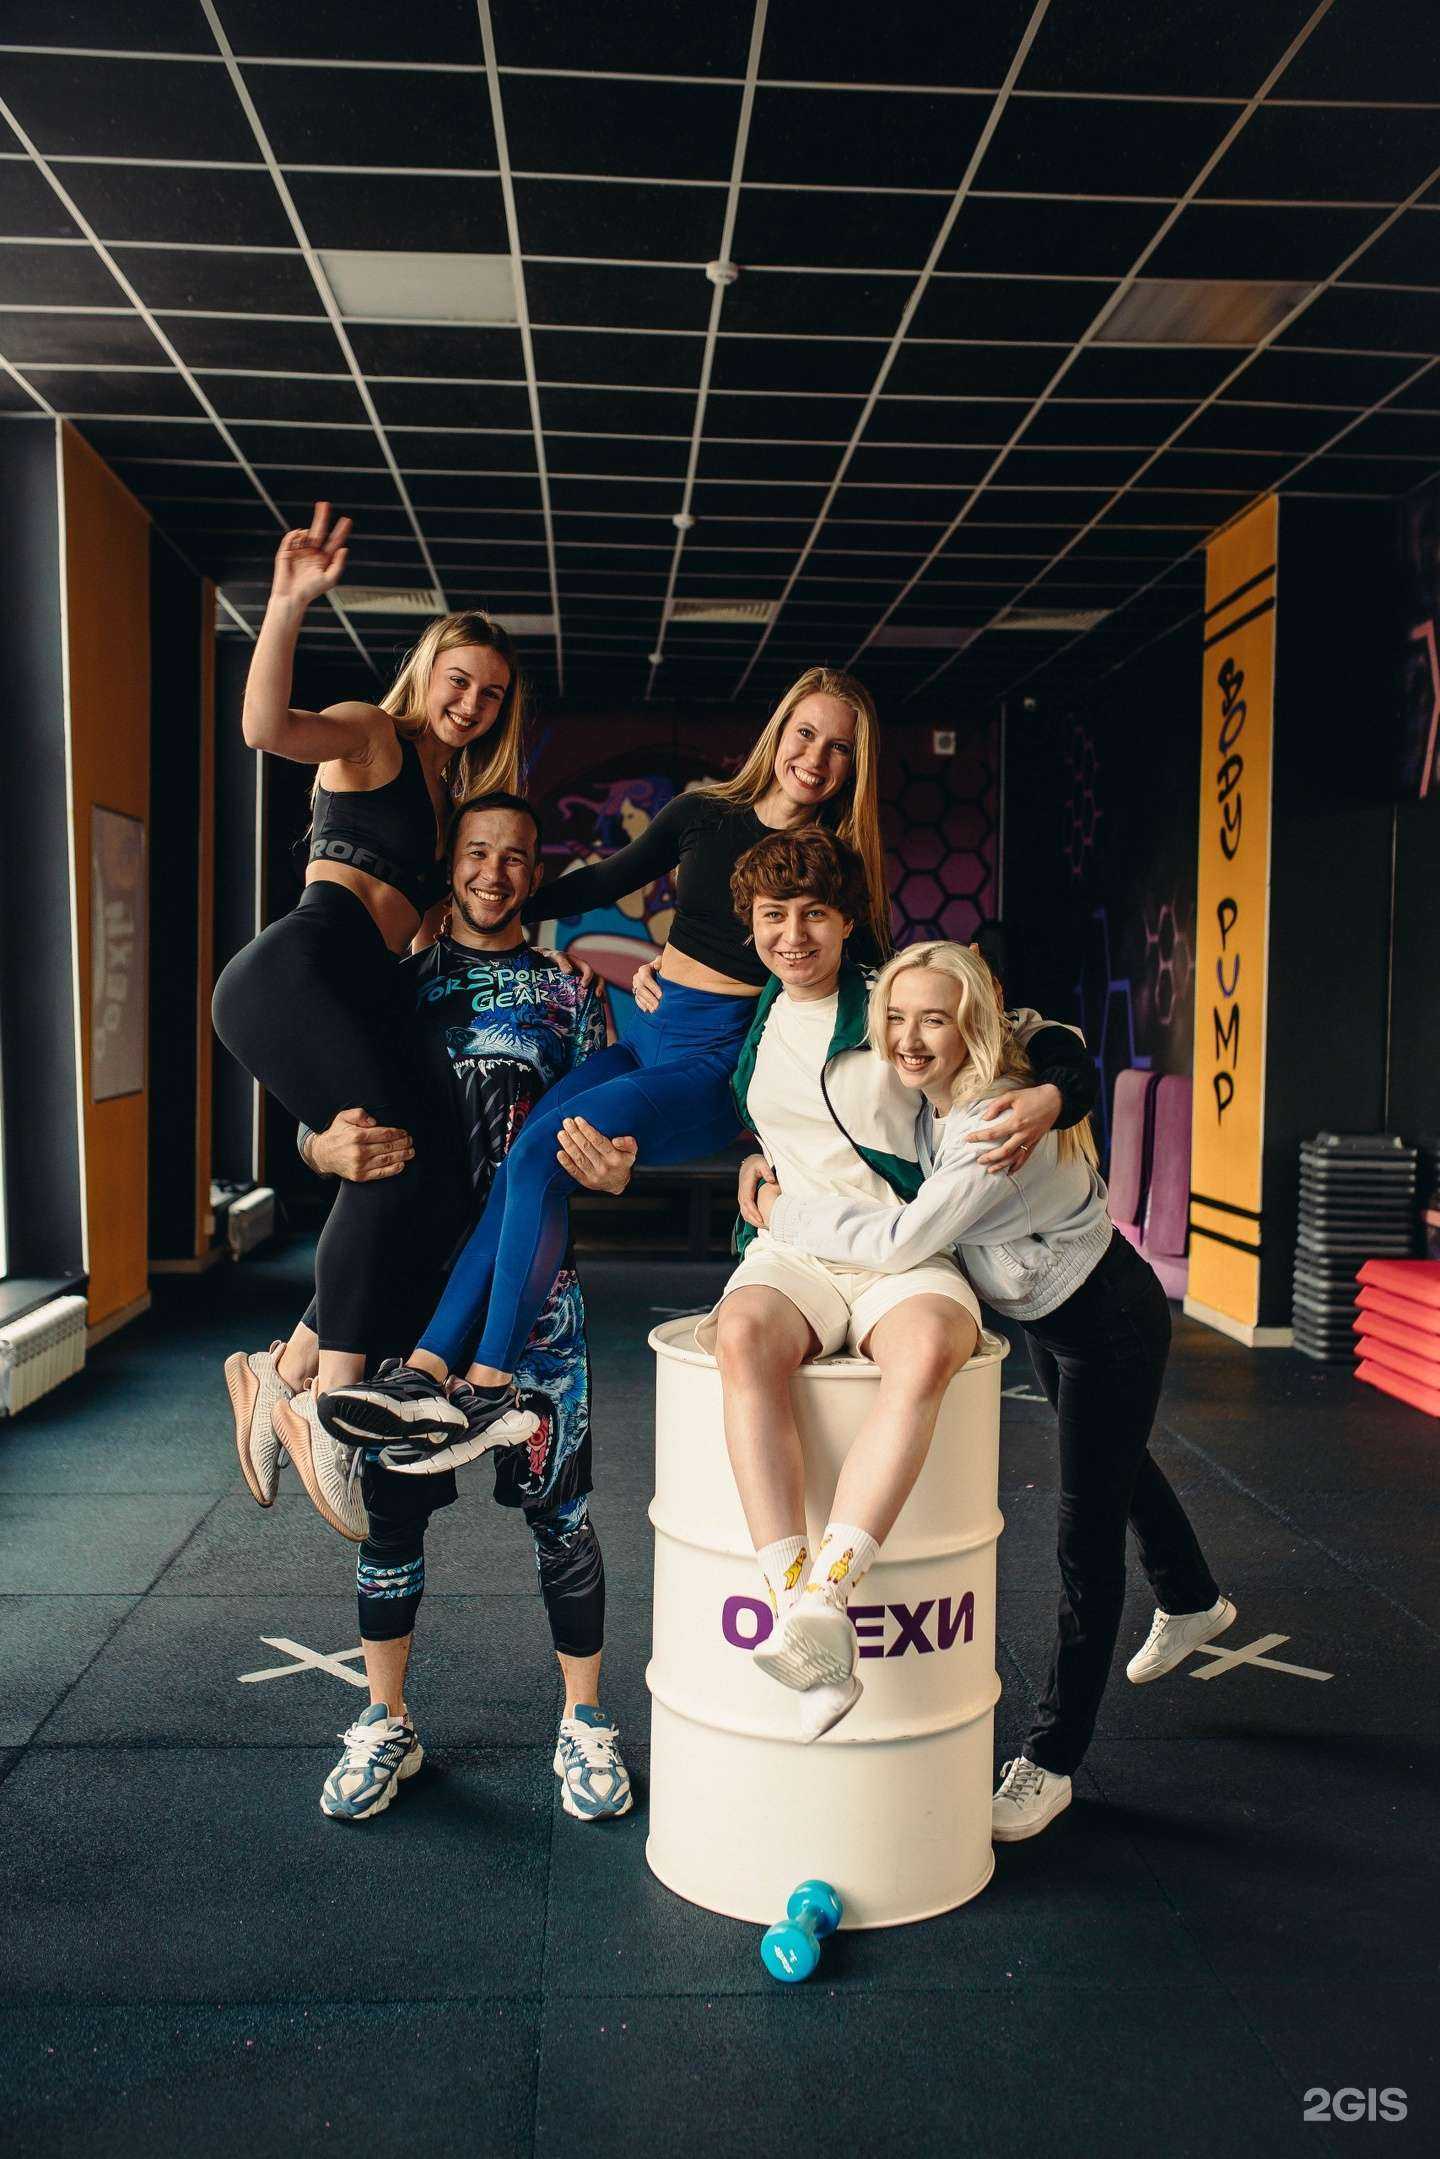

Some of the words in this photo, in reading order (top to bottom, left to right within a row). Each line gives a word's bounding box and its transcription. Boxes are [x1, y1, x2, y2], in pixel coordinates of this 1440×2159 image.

[1217, 657, 1247, 861] BODY
[466, 965, 559, 990] SPORT
[471, 986, 557, 1013] GEAR
[1214, 897, 1239, 1126] PUMP
[722, 1591, 975, 1658] ОЕХИ
